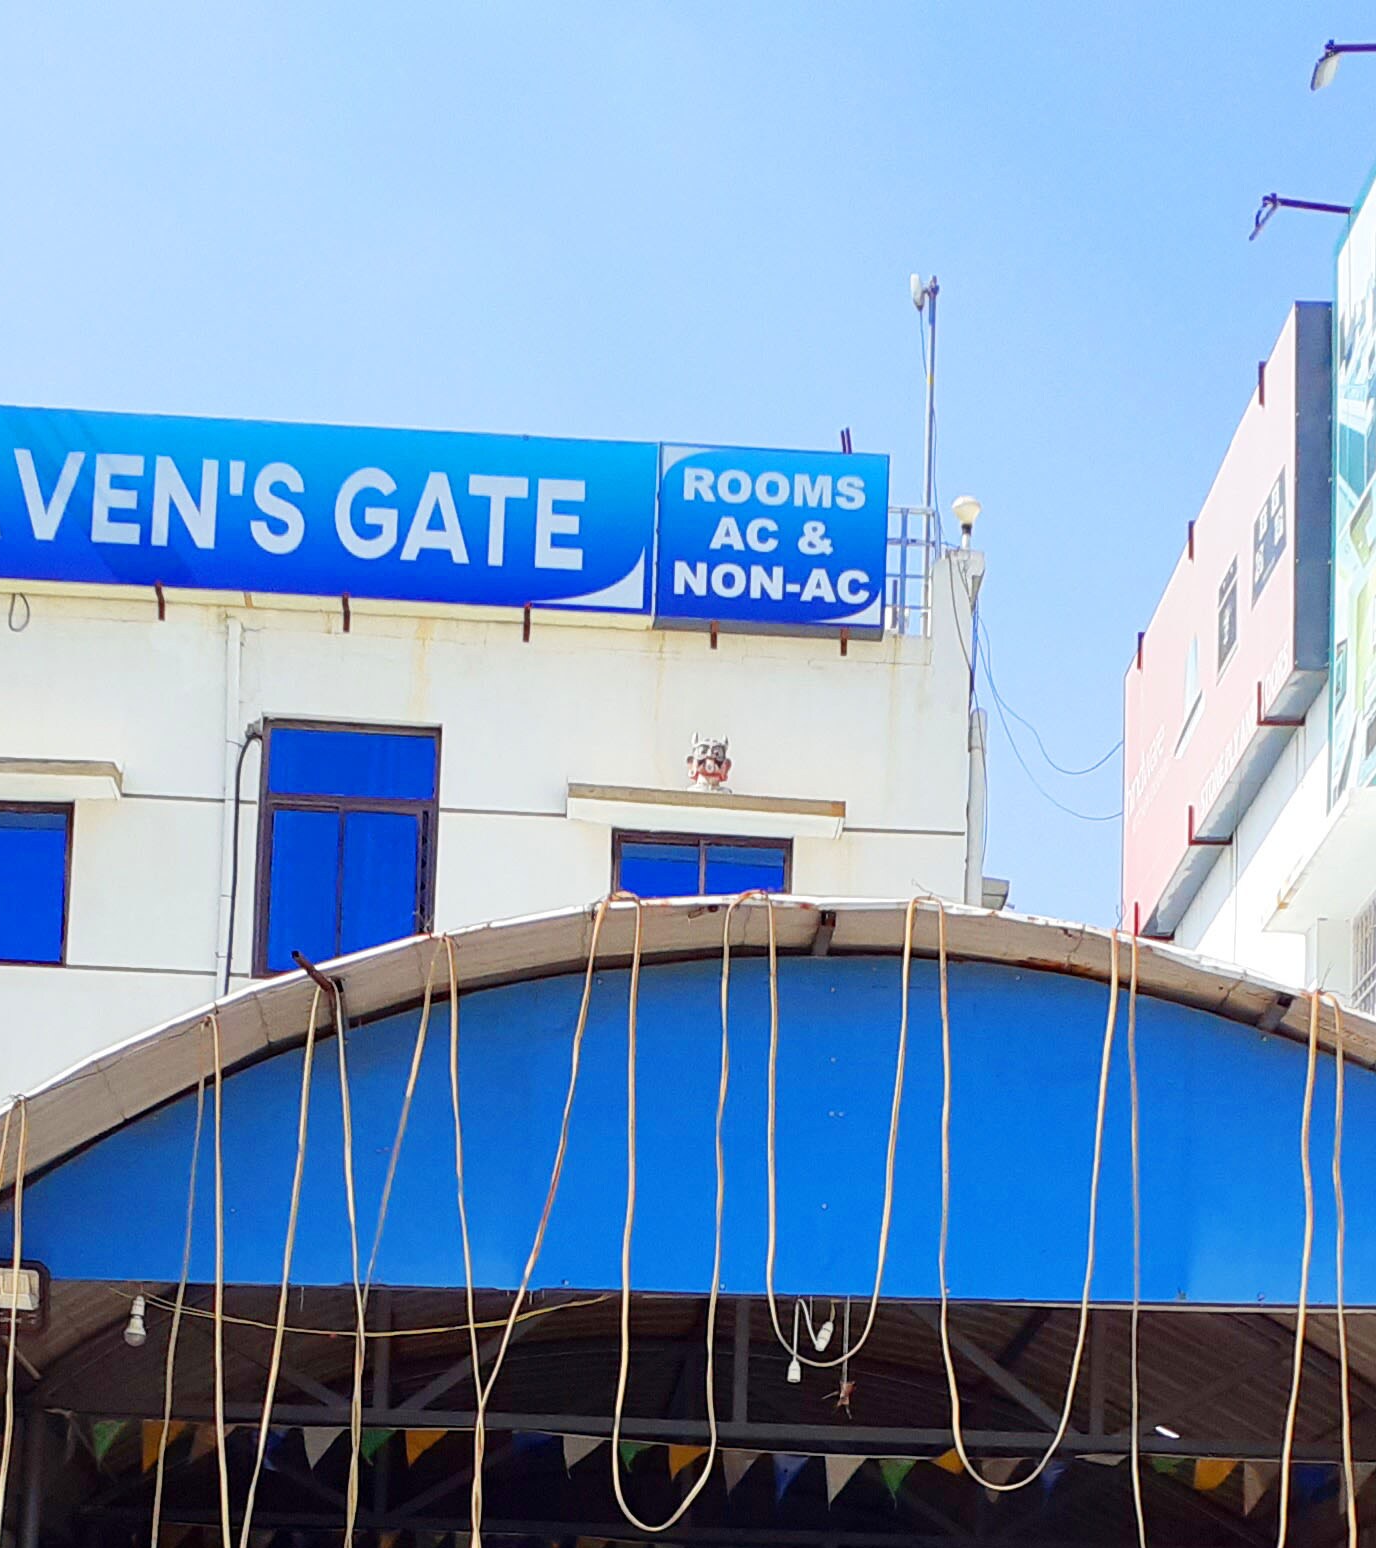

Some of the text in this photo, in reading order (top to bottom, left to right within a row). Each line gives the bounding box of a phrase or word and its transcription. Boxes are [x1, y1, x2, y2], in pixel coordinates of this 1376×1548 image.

[682, 467, 866, 511] ROOMS
[334, 466, 586, 571] GATE
[709, 516, 834, 555] AC &
[673, 560, 870, 605] NON-AC
